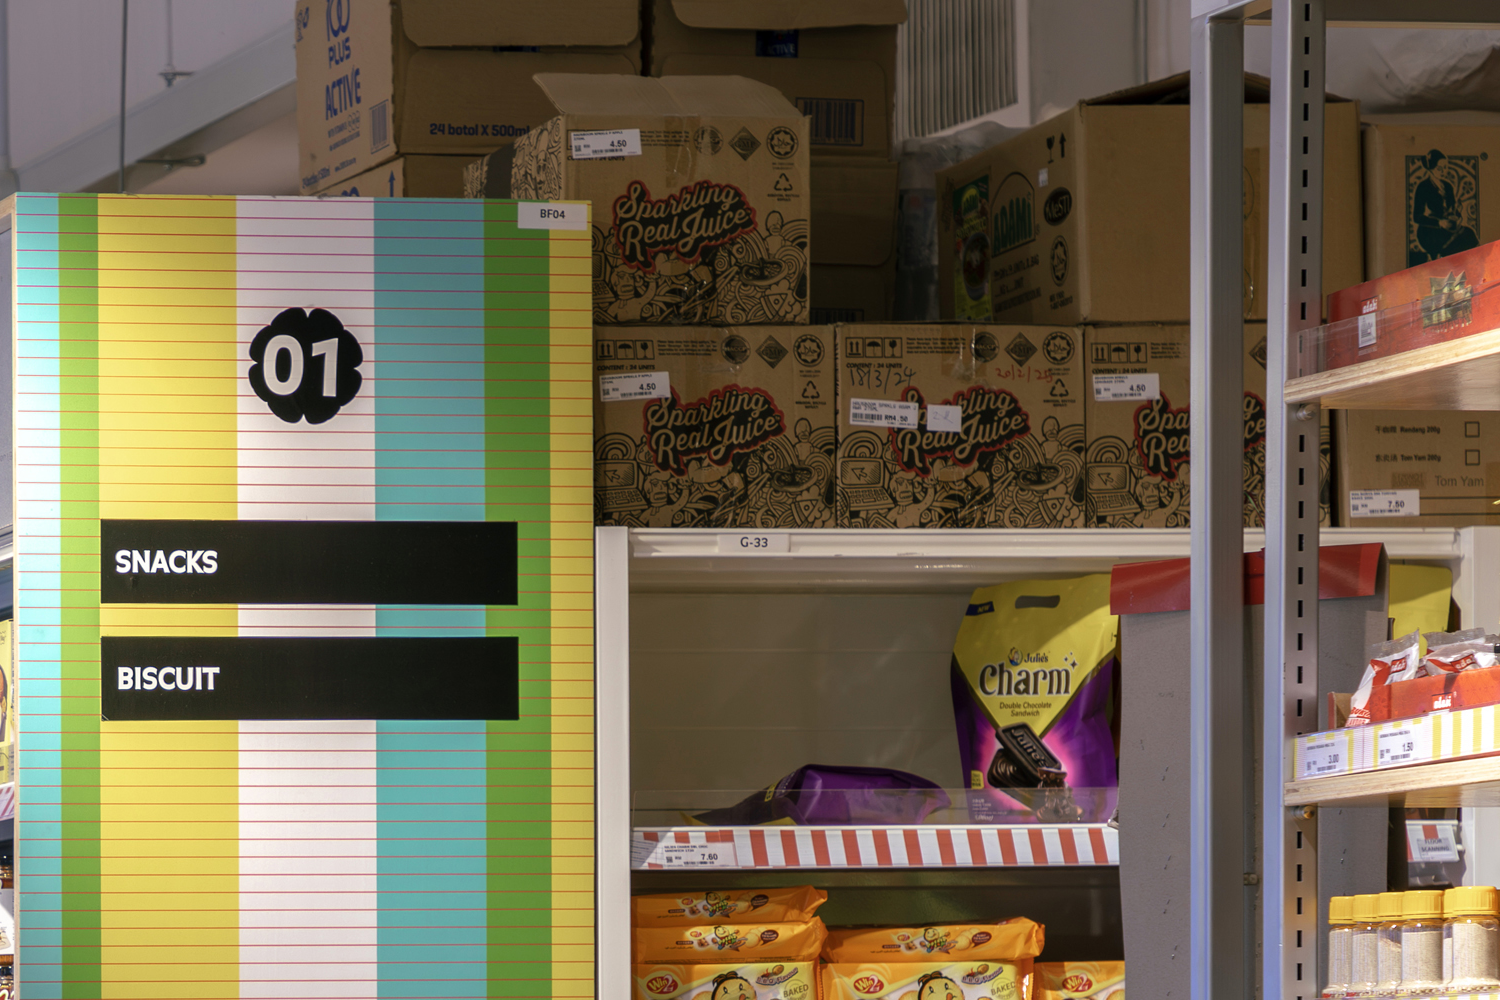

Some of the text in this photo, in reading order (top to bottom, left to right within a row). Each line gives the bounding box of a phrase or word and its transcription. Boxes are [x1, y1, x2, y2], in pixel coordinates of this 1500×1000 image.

[328, 36, 350, 68] PLUS
[326, 68, 361, 120] ACTIVE
[430, 124, 446, 135] 24
[448, 123, 478, 136] botol
[492, 125, 530, 137] 500ml
[610, 140, 627, 148] 4.50
[618, 182, 739, 220] Sparkling
[540, 208, 566, 219] BF04
[620, 207, 748, 261] Real Juice
[264, 334, 339, 398] 01
[647, 392, 768, 428] Sparkling
[956, 414, 1024, 459] Juice
[1400, 426, 1441, 434] Rendang 200g
[652, 414, 778, 468] Real Juice
[1428, 454, 1441, 462] 200g
[1435, 476, 1484, 486] Tom Yam
[1388, 500, 1404, 508] 7.50
[740, 536, 768, 549] G-33
[115, 550, 218, 574] SNACKS
[1024, 652, 1048, 664] Julie's
[117, 667, 220, 690] BISCUIT
[979, 661, 1071, 697] Charm
[1000, 701, 1052, 710] Double Chocolate
[783, 984, 809, 998] BAKED
[990, 981, 1016, 996] BAKED
